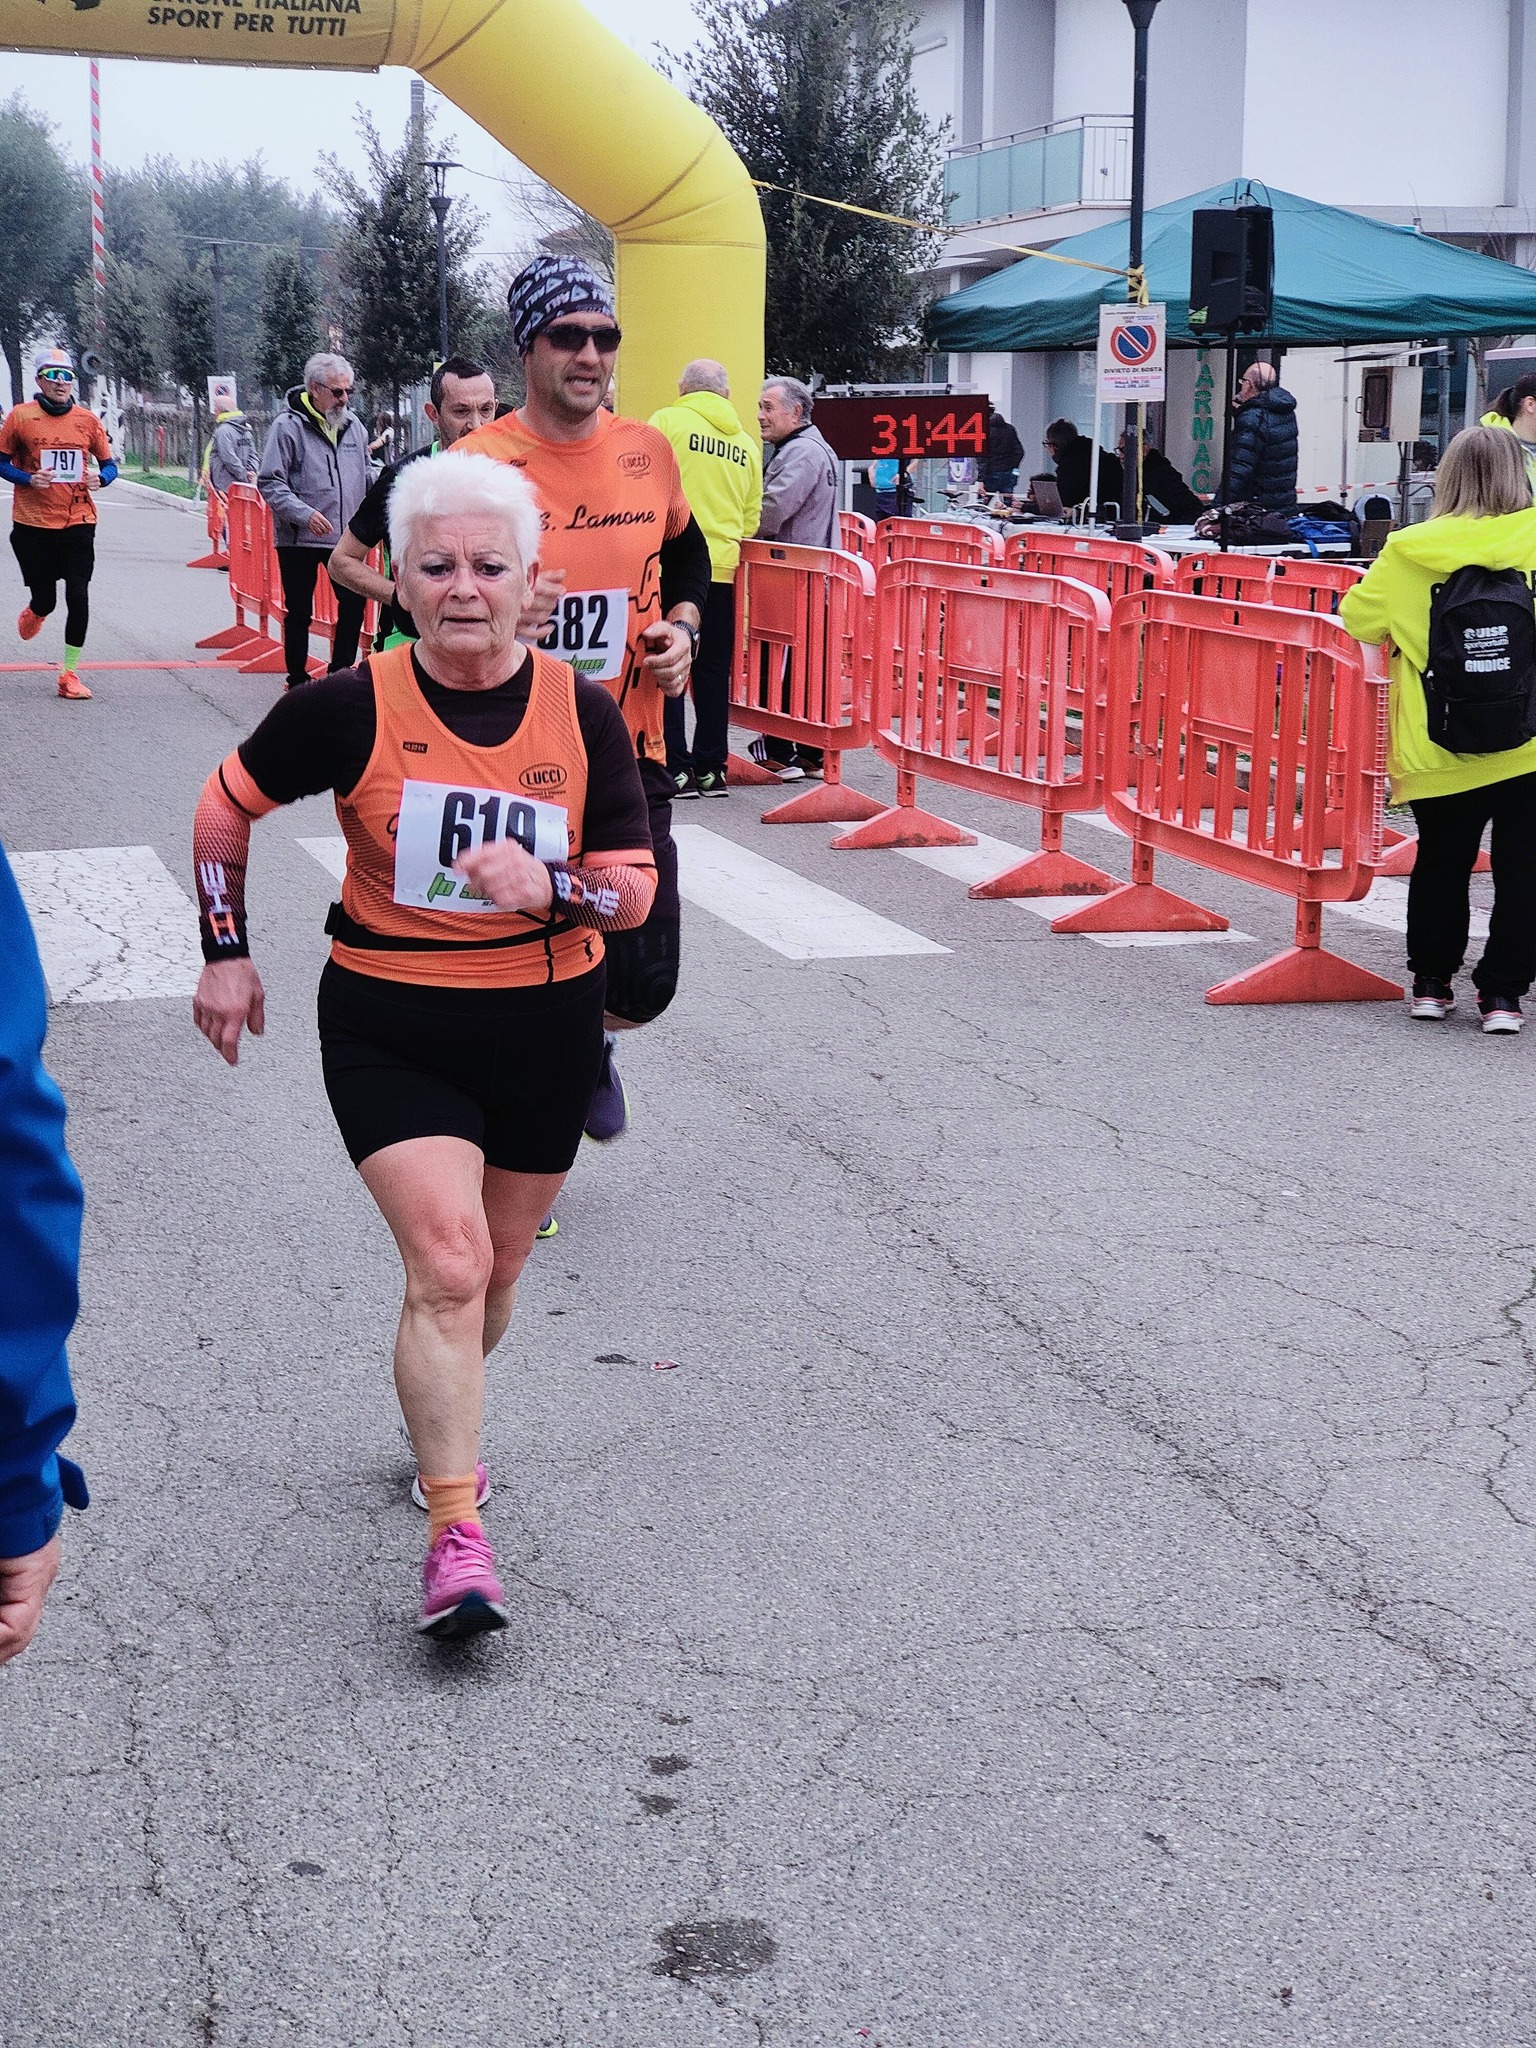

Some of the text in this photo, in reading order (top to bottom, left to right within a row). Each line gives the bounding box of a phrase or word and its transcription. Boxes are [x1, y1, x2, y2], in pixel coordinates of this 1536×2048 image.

[148, 6, 346, 36] SPORT PER TUTTI
[871, 412, 987, 455] 31:44
[51, 450, 76, 471] 797
[689, 433, 747, 467] GIUDICE
[564, 504, 657, 530] Lamone
[1475, 625, 1508, 638] UISP
[1464, 656, 1511, 673] GIUDICE
[526, 769, 561, 785] LUCCI
[438, 791, 537, 869] 619
